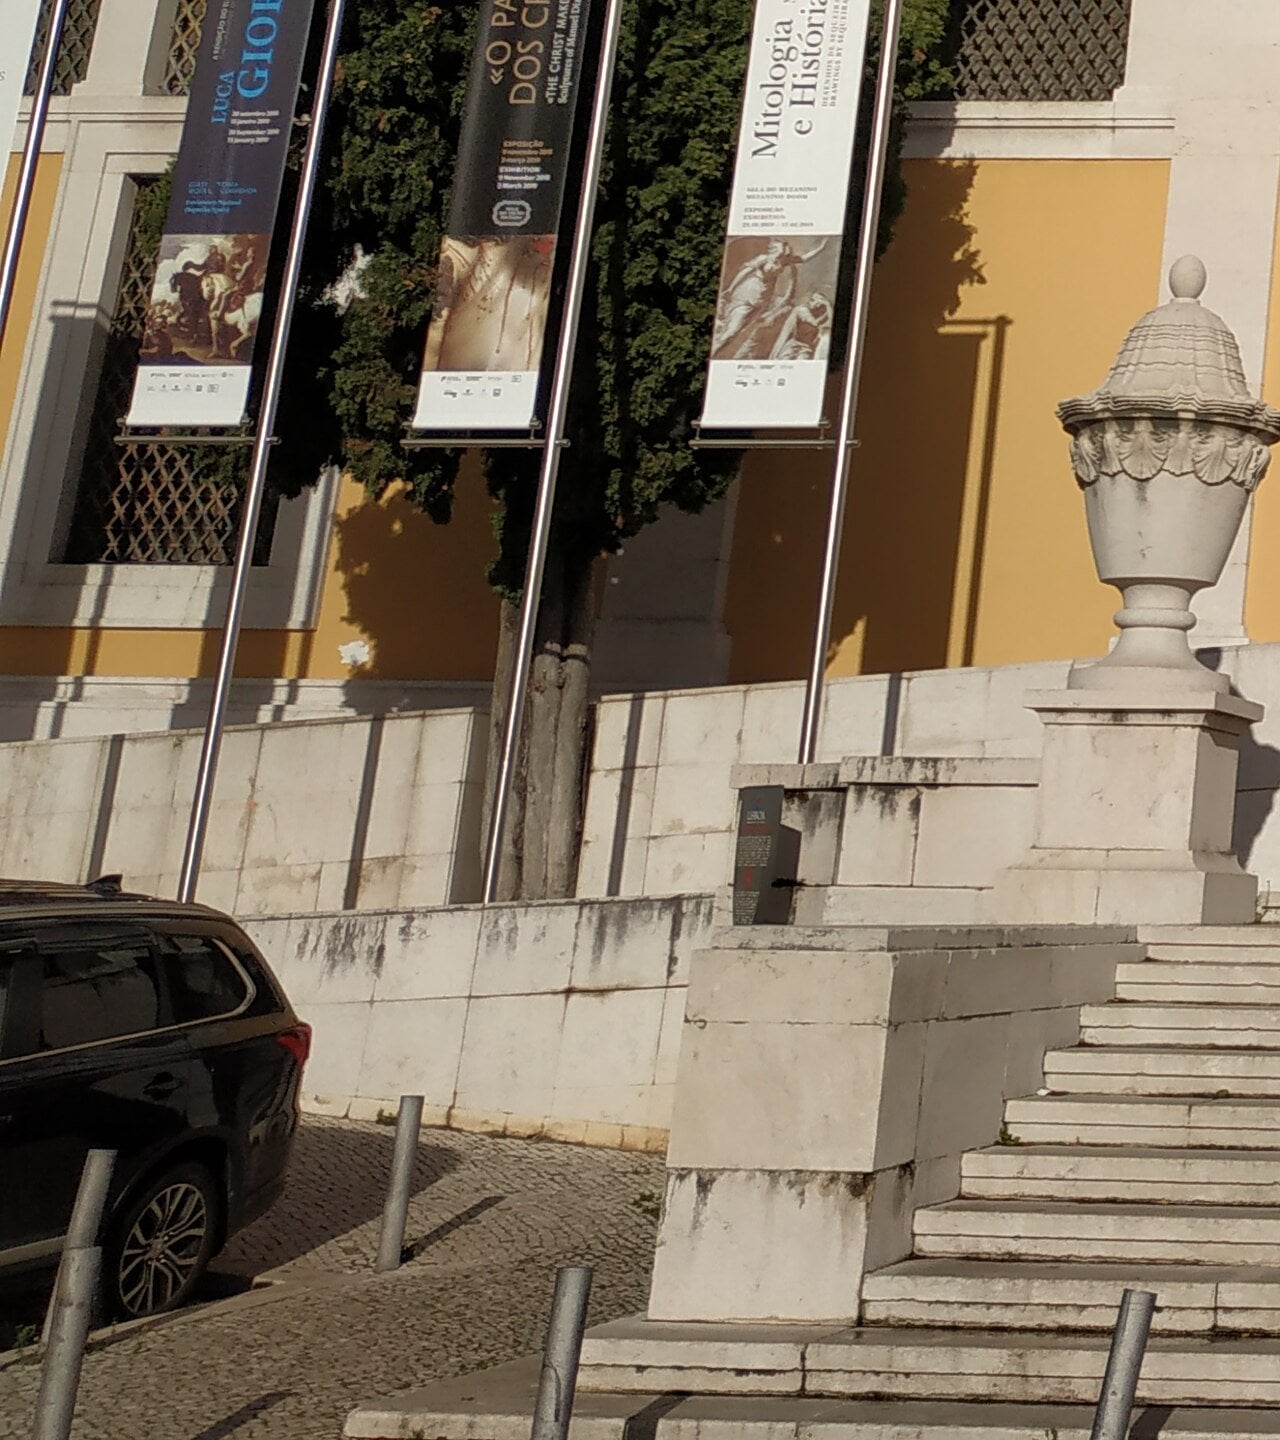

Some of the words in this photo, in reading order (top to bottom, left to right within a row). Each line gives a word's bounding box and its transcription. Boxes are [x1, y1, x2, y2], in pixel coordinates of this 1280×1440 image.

[549, 32, 565, 73] CHRIST
[564, 47, 574, 58] of
[566, 15, 581, 48] Manuel
[509, 39, 543, 105] DOS
[558, 58, 574, 104] Sculptures
[750, 18, 798, 159] Mitologia
[211, 70, 235, 124] LUCA
[793, 119, 814, 136] e
